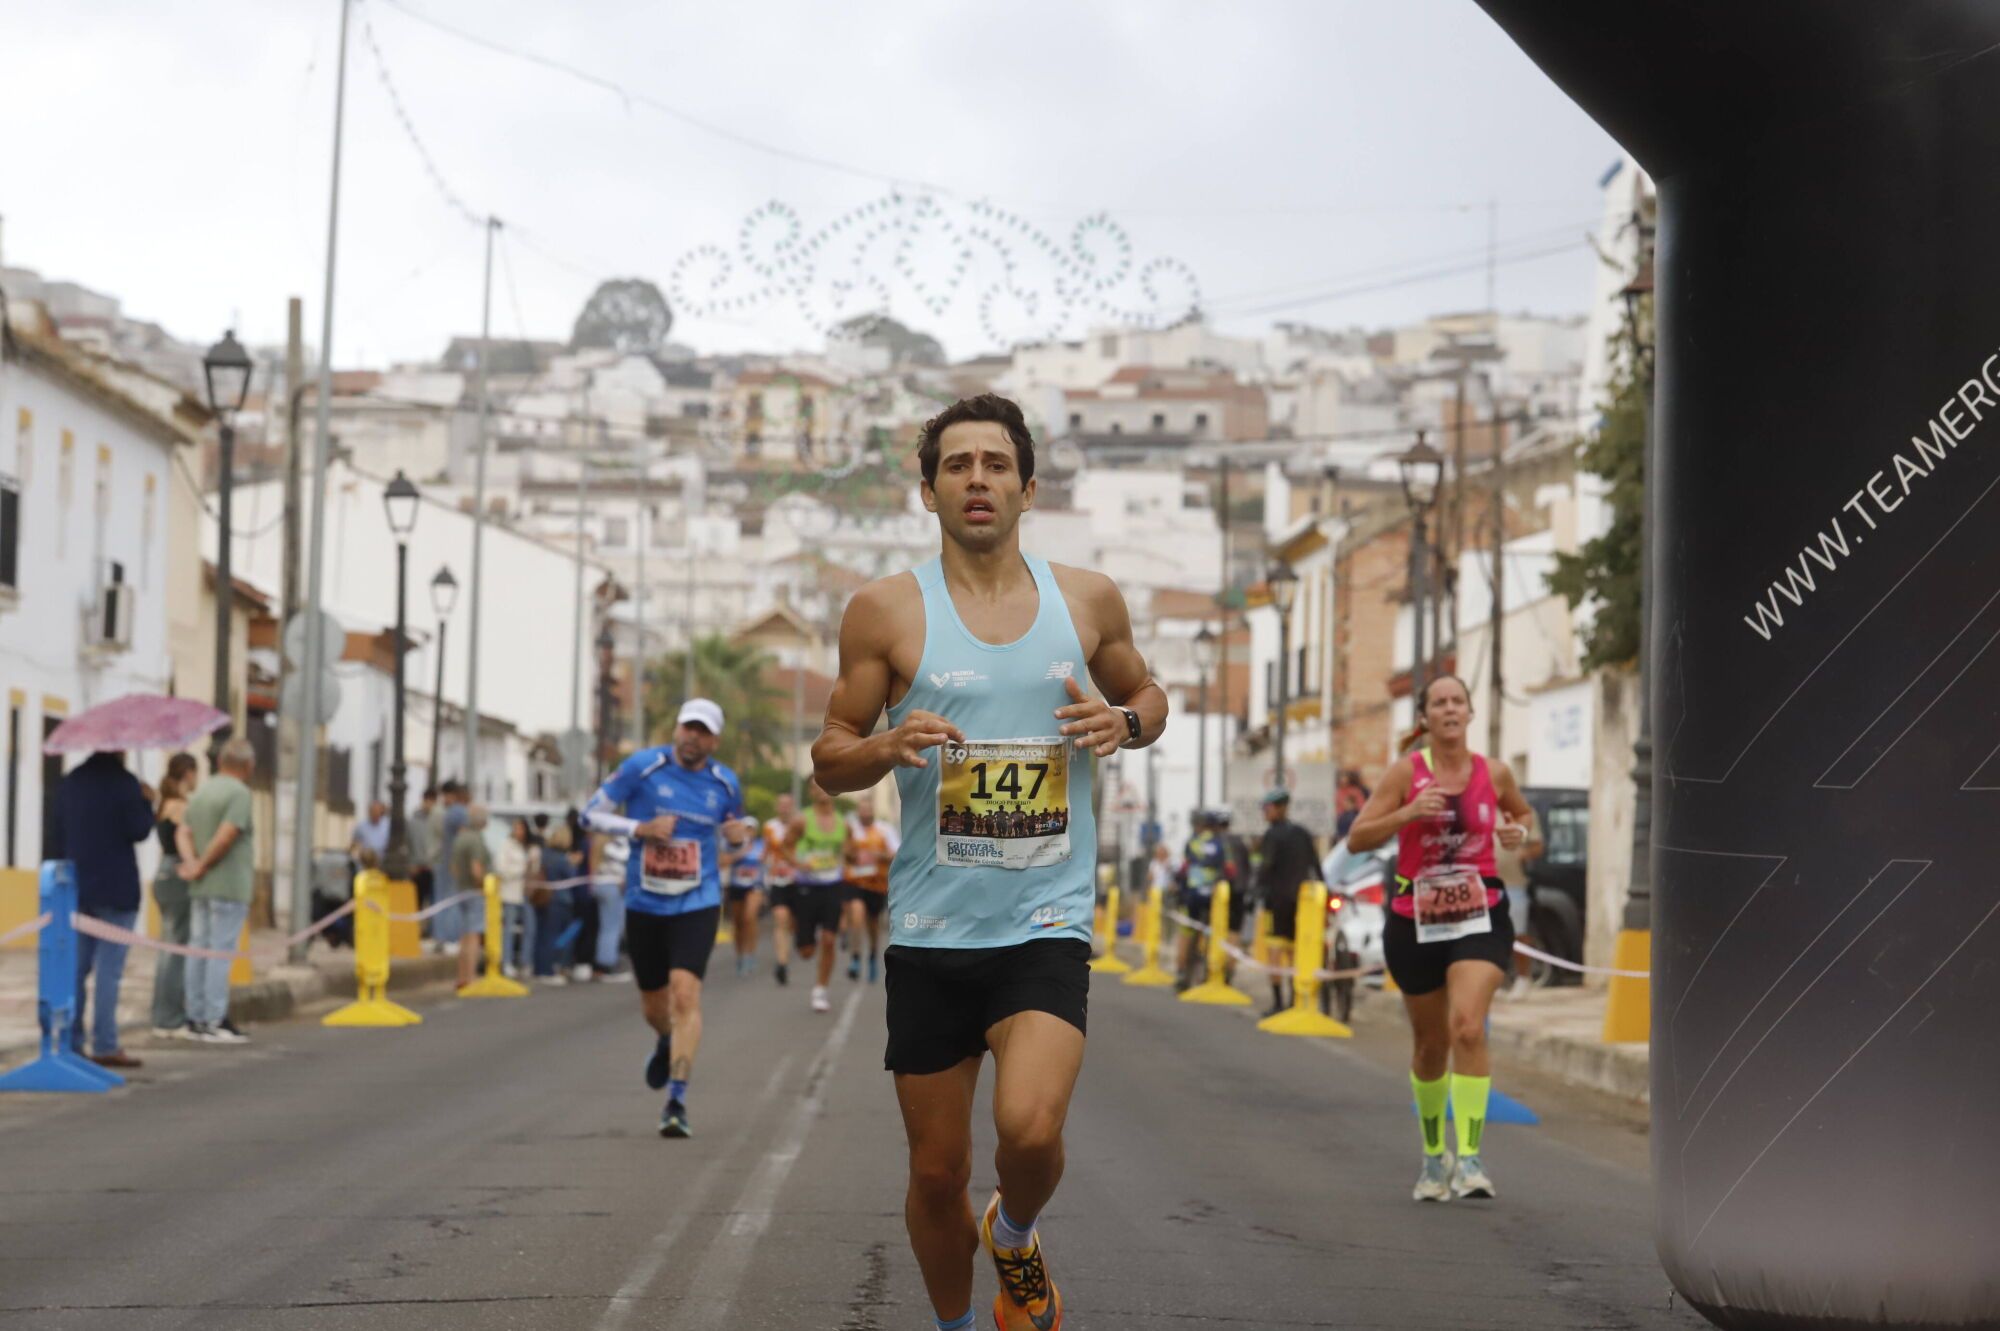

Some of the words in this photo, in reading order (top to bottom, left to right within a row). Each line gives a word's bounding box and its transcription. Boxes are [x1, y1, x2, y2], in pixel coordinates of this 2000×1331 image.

[1744, 345, 2000, 641] WWW.TEAMERG
[945, 749, 968, 764] 39
[970, 763, 1049, 800] 147
[947, 841, 995, 850] carreras
[947, 848, 1004, 858] populares
[1431, 883, 1472, 906] 788
